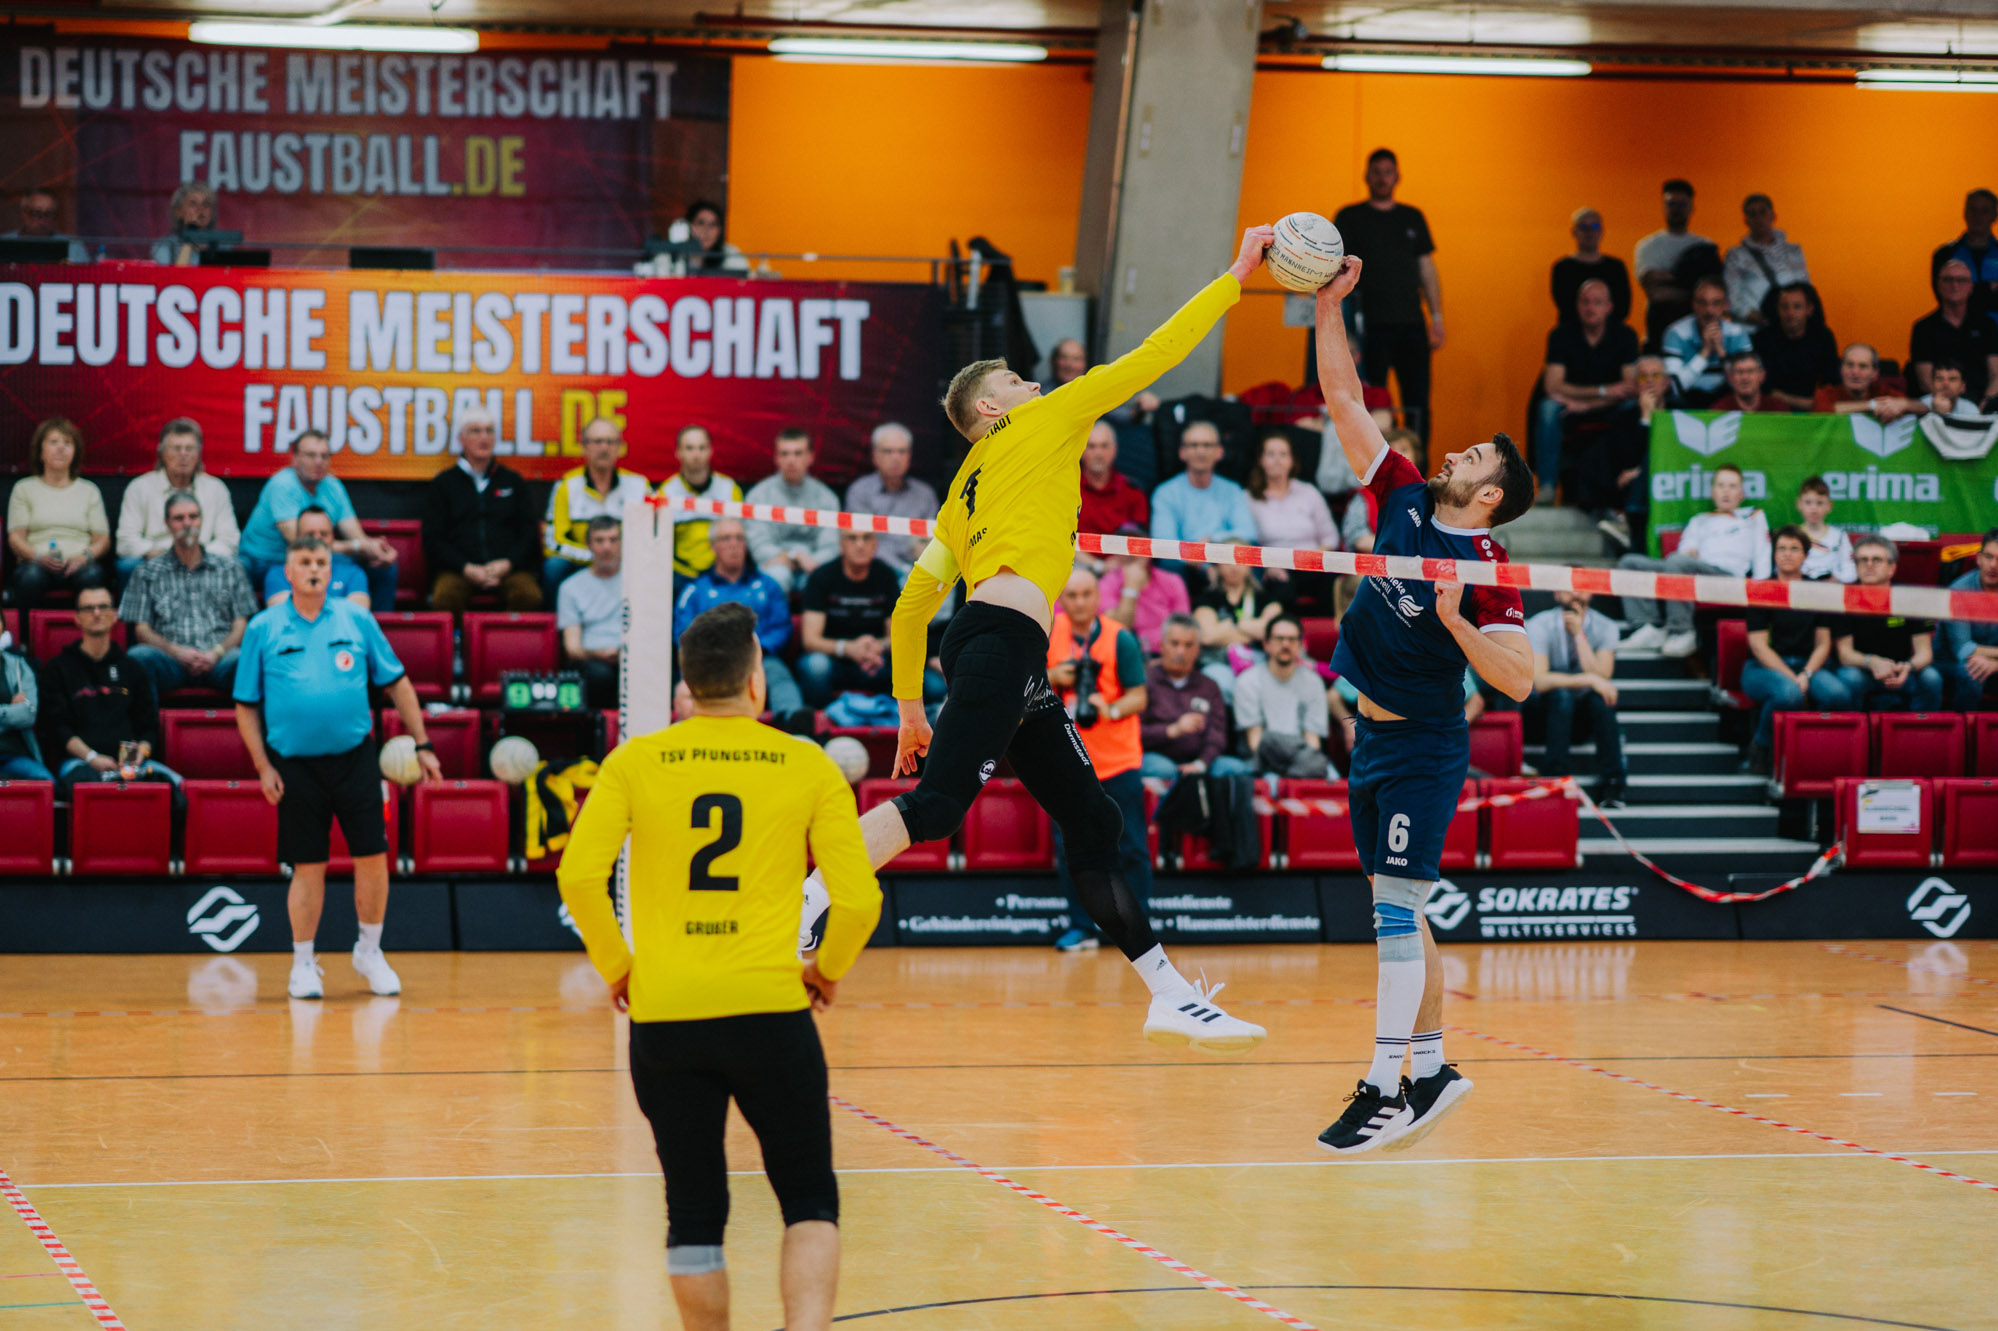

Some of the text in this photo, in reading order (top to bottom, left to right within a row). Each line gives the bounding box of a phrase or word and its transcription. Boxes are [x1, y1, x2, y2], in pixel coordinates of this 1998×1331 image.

[20, 47, 676, 120] DEUTSCHE MEISTERSCHAFT
[180, 130, 526, 196] FAUSTBALL.DE
[0, 282, 870, 380] DEUTSCHE MEISTERSCHAFT
[1652, 465, 1767, 501] eria
[1822, 466, 1940, 501] erima
[1408, 508, 1421, 527] JAKO
[661, 748, 786, 765] TSV PFUNGSTADT
[1064, 723, 1090, 766] Darmstadt
[689, 793, 743, 891] 2
[1388, 813, 1410, 852] 6
[1386, 856, 1408, 866] JAKO
[1476, 886, 1631, 912] SOKRATES
[1480, 924, 1638, 937] MULTISERVICES
